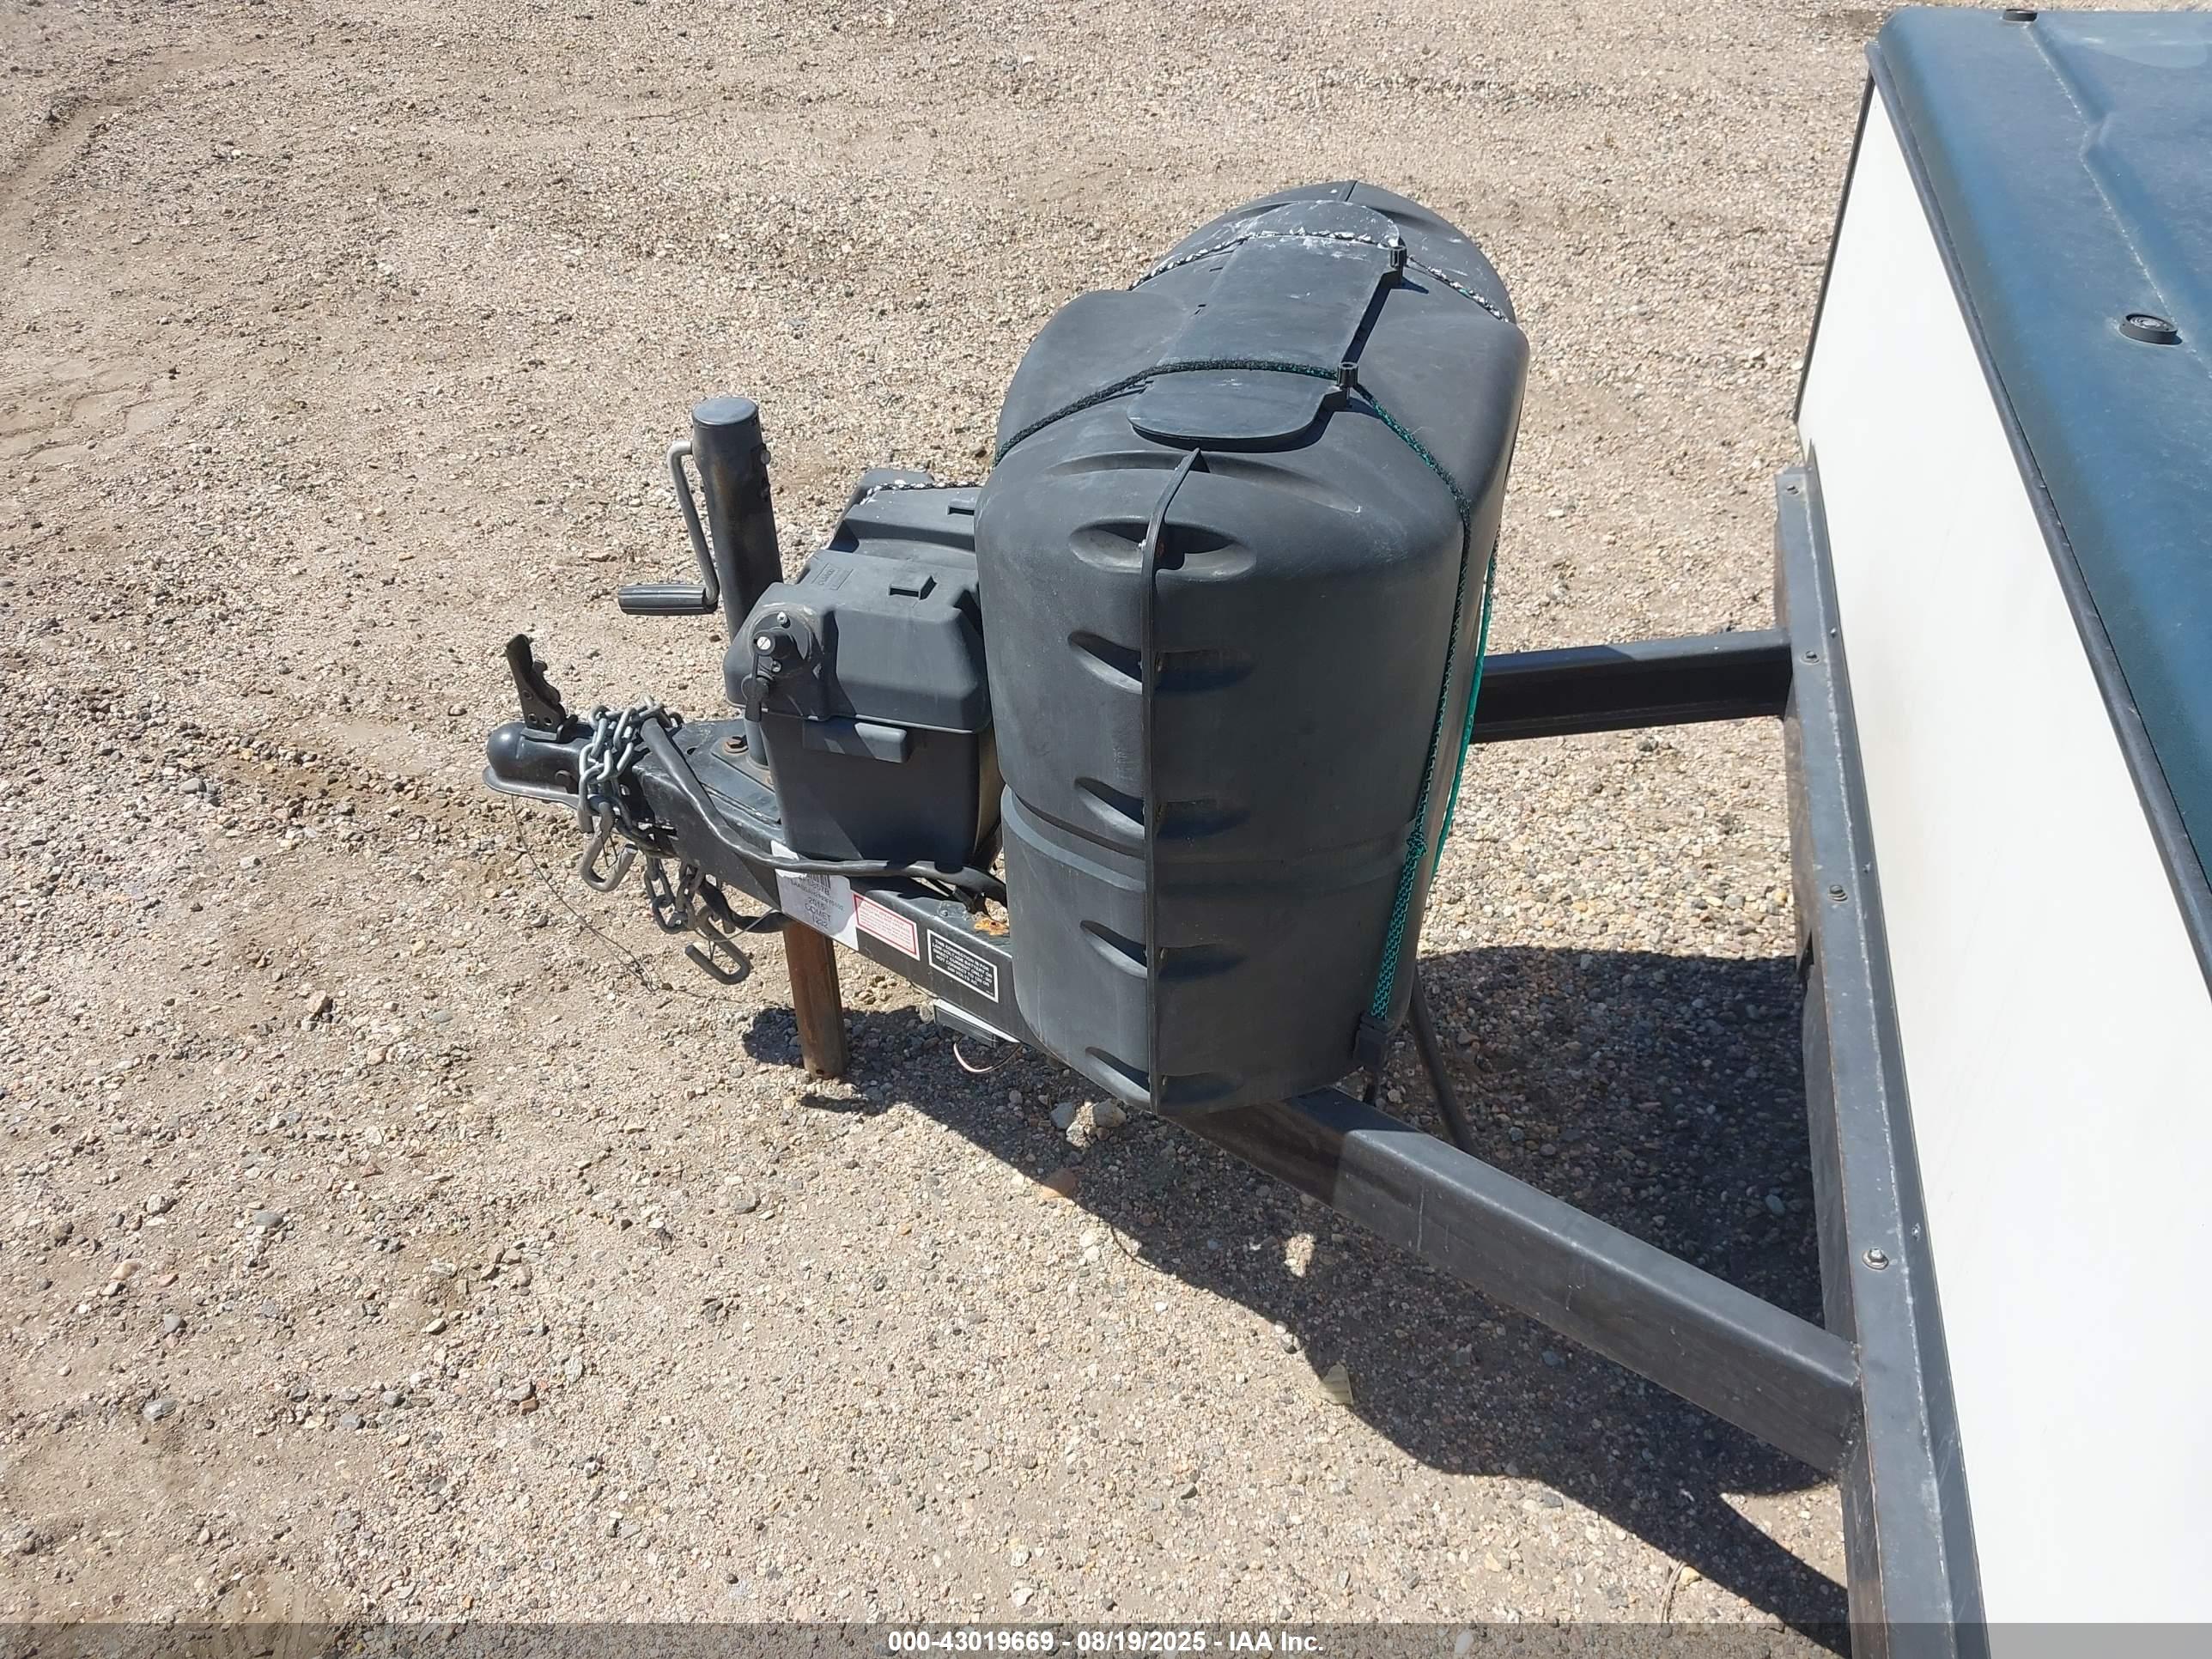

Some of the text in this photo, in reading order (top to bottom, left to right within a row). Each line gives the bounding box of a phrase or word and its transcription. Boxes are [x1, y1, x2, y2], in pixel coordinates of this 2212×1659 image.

[805, 902, 831, 921] COMET
[932, 942, 964, 963] LOW-VOLTAGE
[963, 958, 986, 975] BATTERY
[933, 948, 950, 959] DIRECT
[949, 957, 971, 971] CURRENT
[945, 945, 975, 963] CONNECTION
[979, 963, 990, 972] FOR
[945, 959, 967, 975] CONNECT
[955, 969, 970, 981] VOLTS
